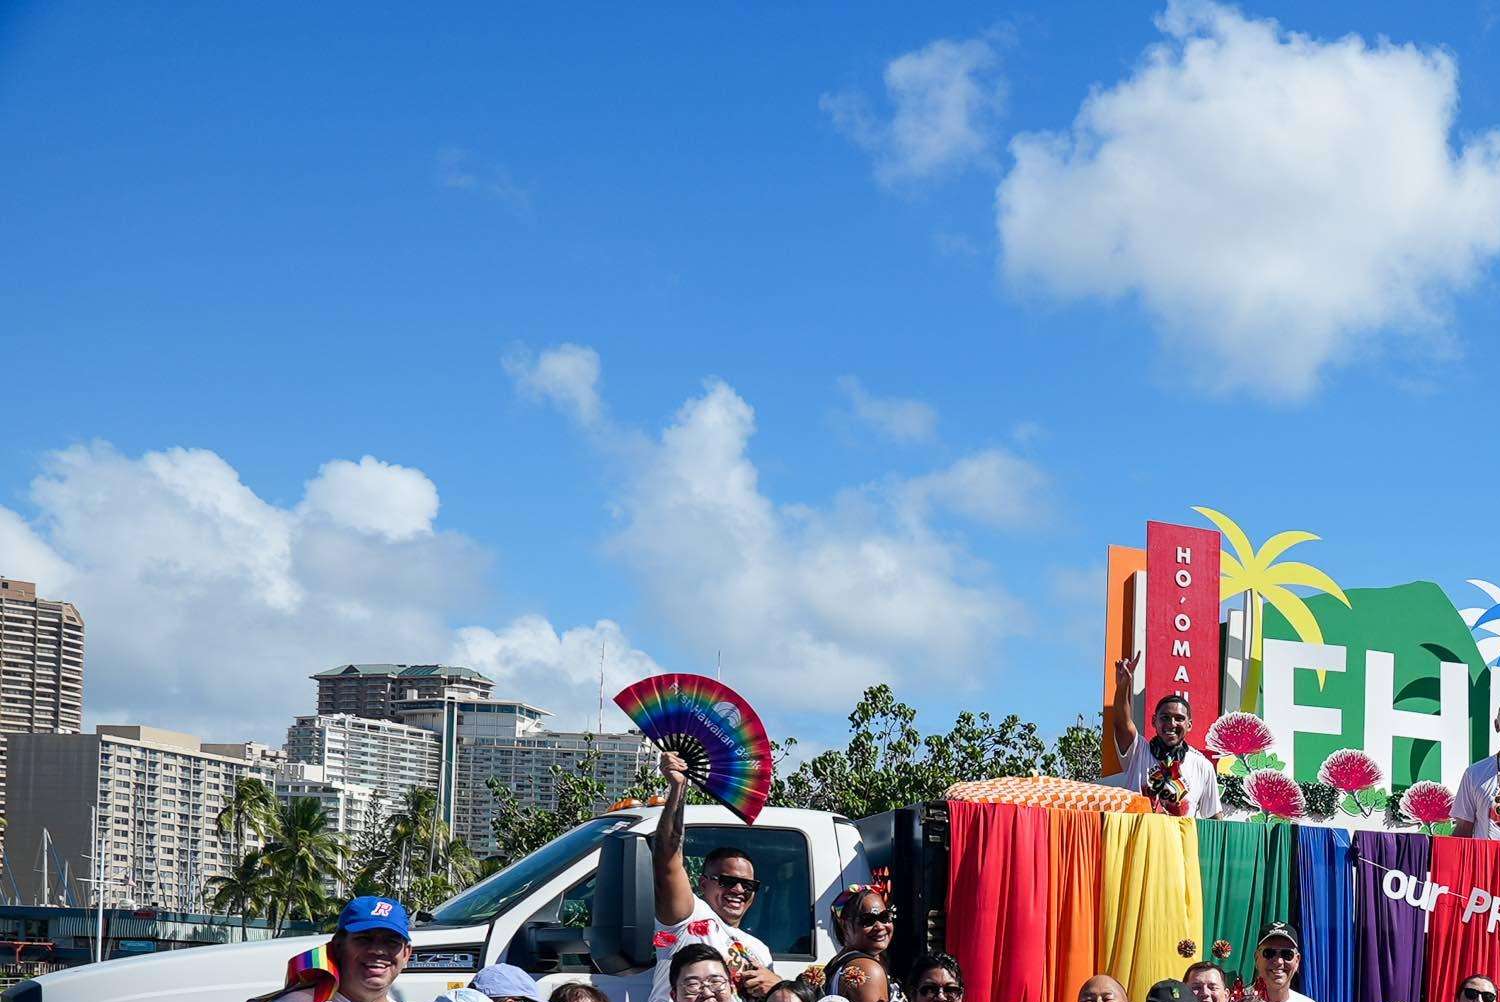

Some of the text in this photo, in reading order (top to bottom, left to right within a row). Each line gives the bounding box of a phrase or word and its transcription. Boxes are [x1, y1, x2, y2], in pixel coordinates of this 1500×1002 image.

[692, 704, 735, 747] Hawaiian
[371, 901, 393, 917] R
[1382, 869, 1449, 911] our
